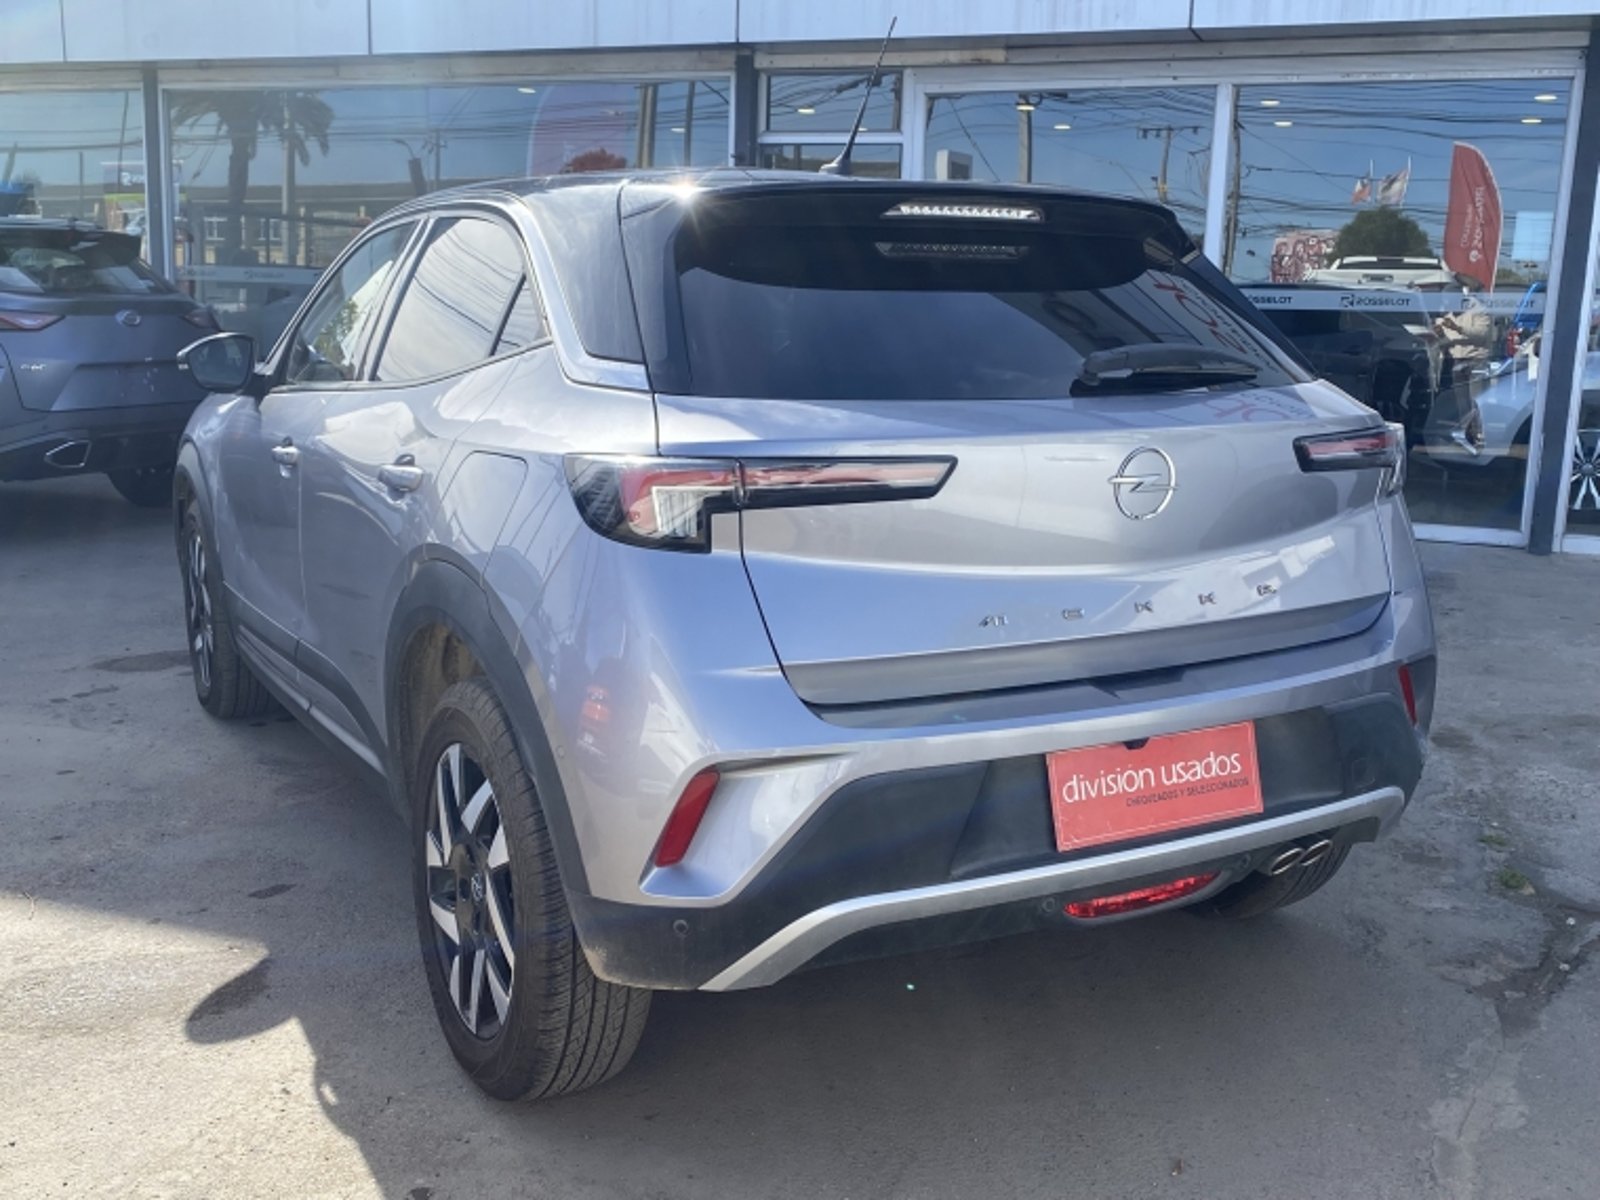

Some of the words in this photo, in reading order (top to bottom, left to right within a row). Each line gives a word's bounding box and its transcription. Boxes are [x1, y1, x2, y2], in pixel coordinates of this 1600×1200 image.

[1062, 763, 1156, 804] división
[1160, 752, 1242, 786] usados
[1186, 777, 1250, 797] SELECCIONADOS
